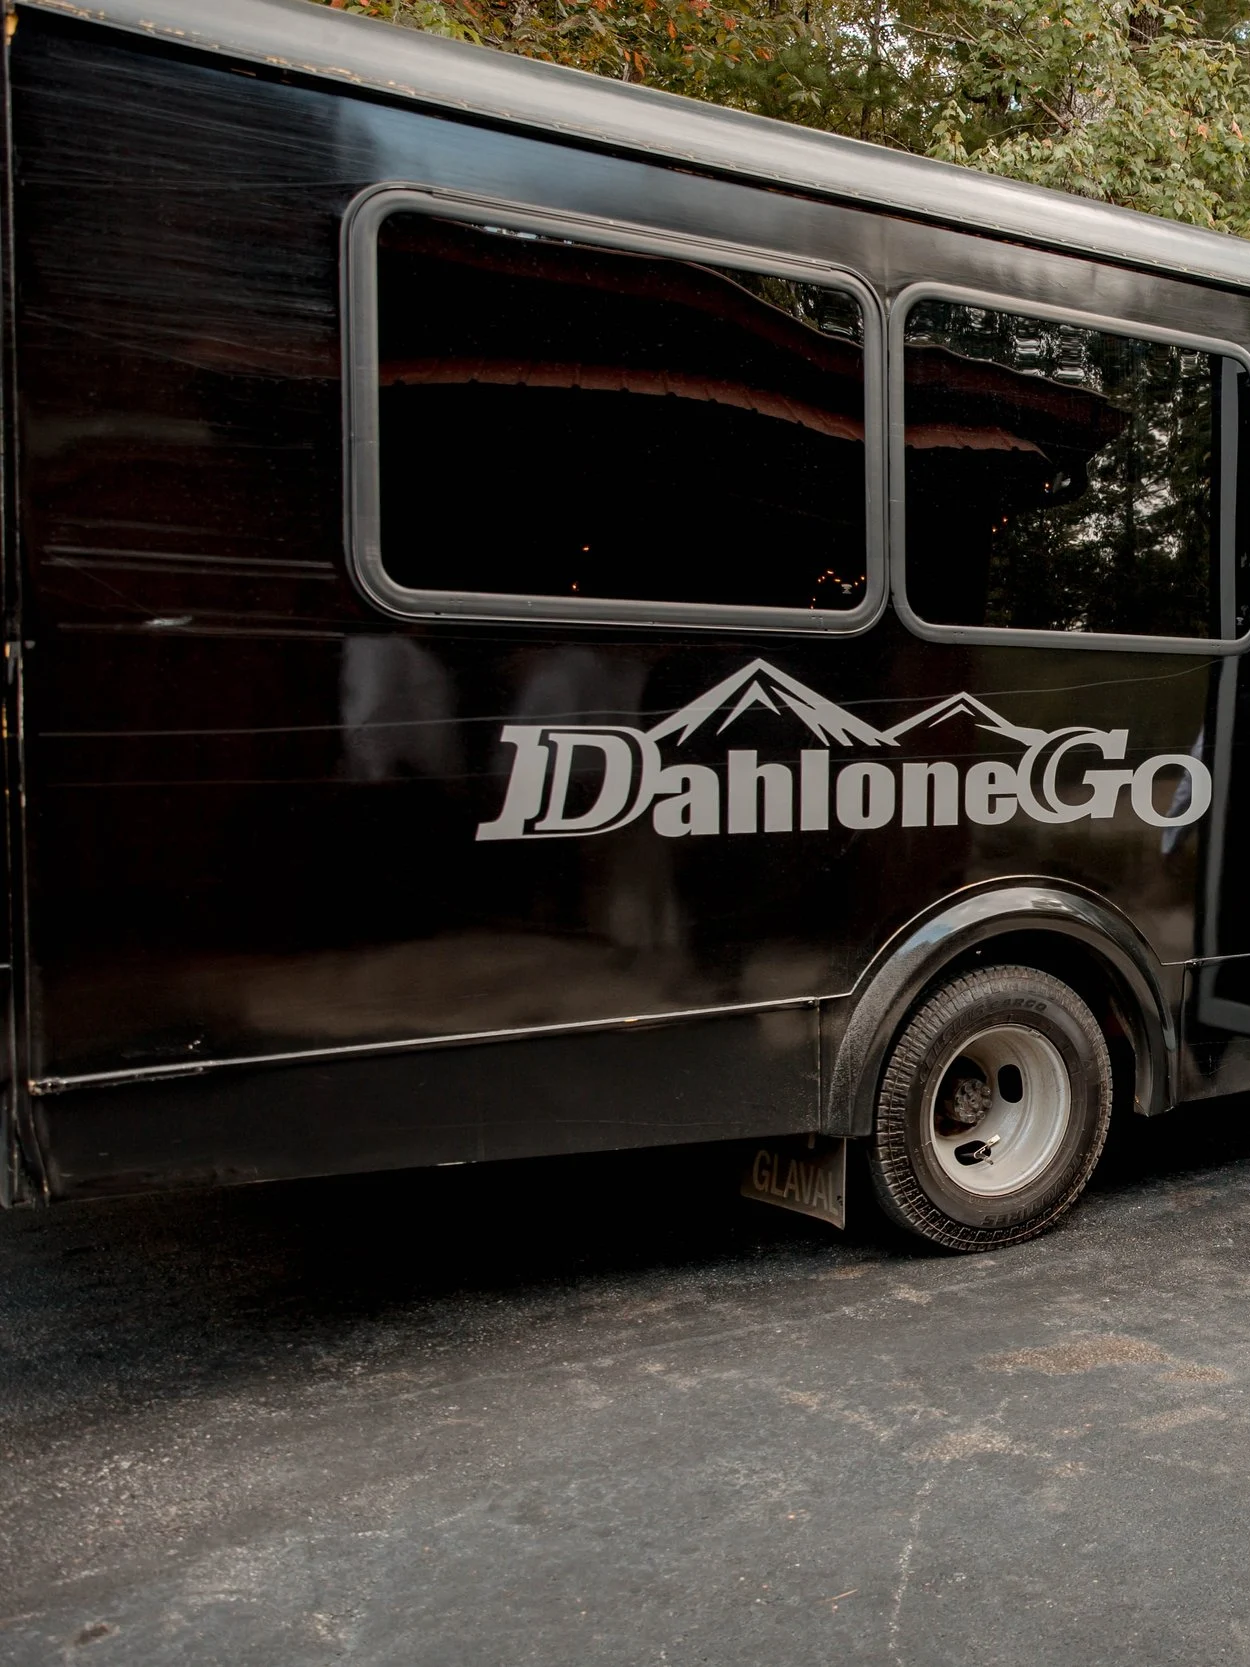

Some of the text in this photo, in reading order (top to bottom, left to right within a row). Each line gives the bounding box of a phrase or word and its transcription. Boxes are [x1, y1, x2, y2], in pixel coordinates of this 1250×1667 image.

[475, 725, 1212, 841] DahloneGo
[991, 998, 1048, 1012] CARGO
[752, 1150, 839, 1216] GLAVAL
[1041, 1153, 1083, 1209] TOYO
